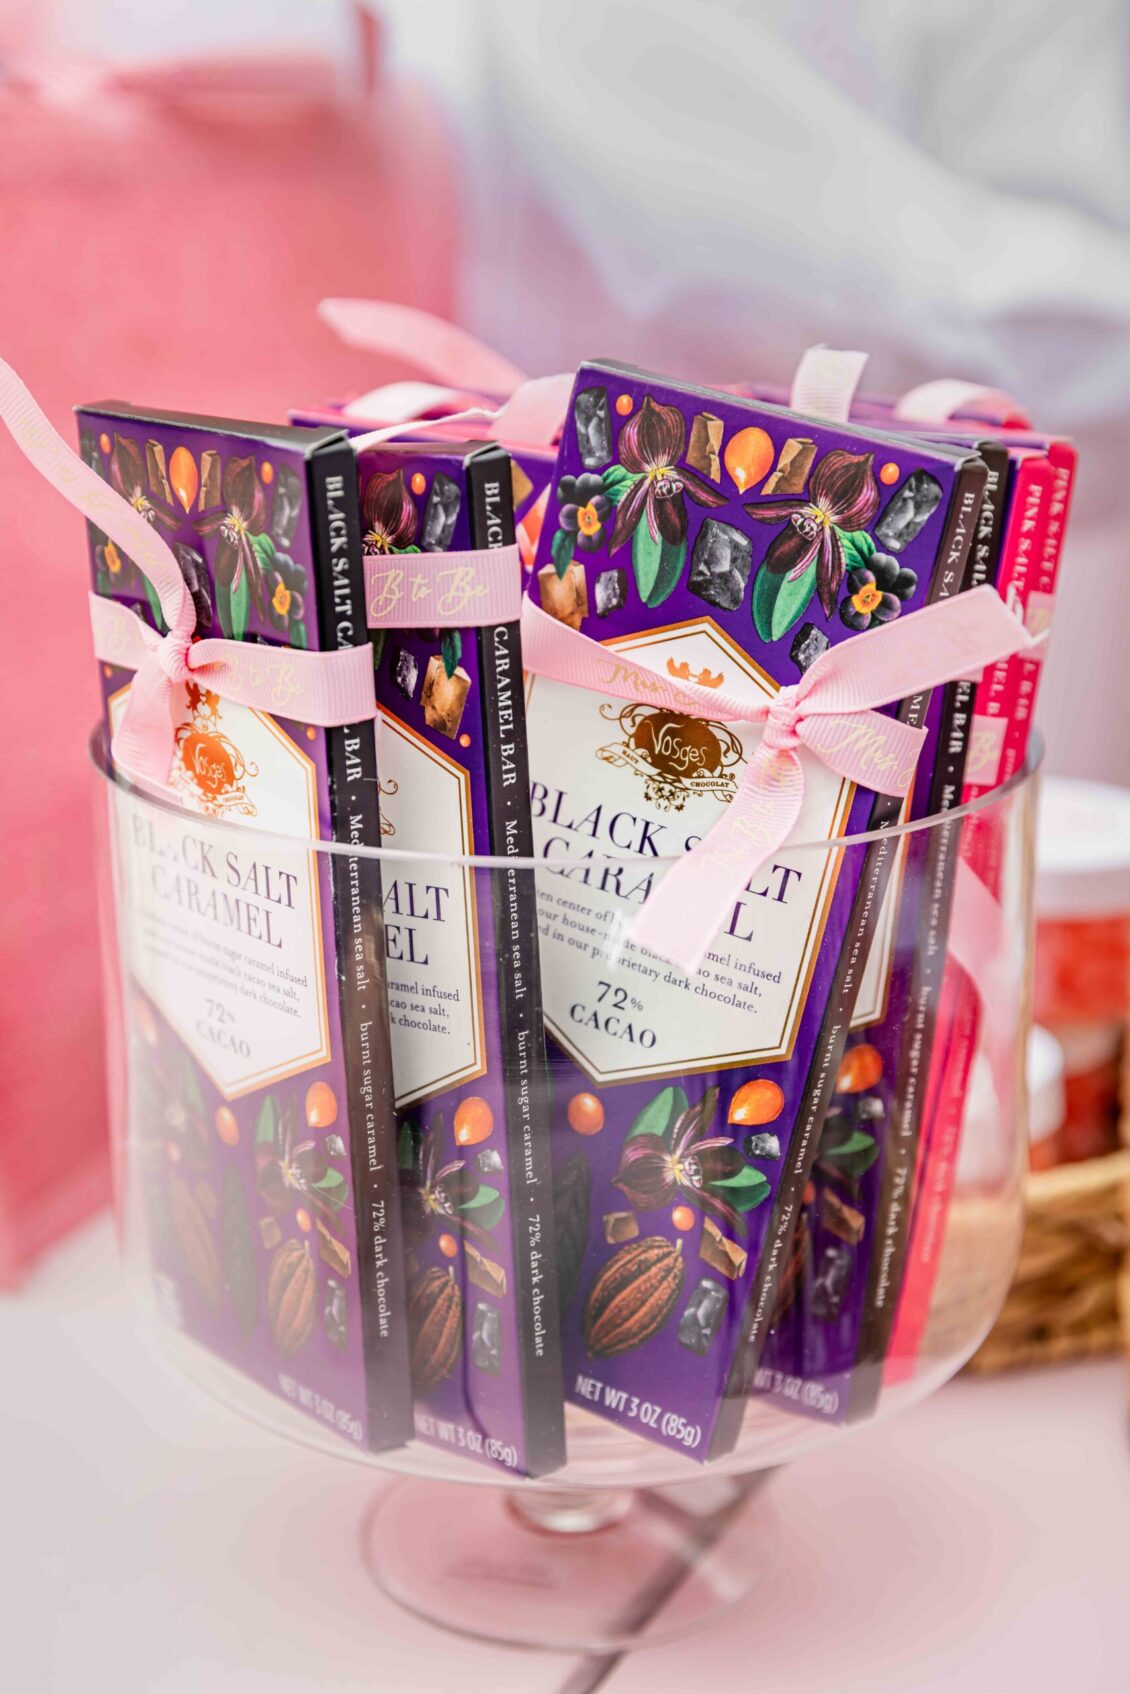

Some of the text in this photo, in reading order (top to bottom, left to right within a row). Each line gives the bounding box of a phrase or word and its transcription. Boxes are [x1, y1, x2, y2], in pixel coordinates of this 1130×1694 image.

[325, 475, 349, 553] BLACK
[977, 470, 999, 539] BLACK
[1020, 483, 1043, 533] PINK
[947, 492, 975, 565] BLACK
[331, 557, 352, 615] SALT
[939, 570, 954, 598] SA
[971, 544, 990, 588] SAL
[370, 566, 490, 617] B to Be
[493, 626, 515, 738] CARAMEL
[645, 720, 708, 771] Vosges
[948, 712, 967, 754] BAR
[190, 743, 227, 788] Vosges
[344, 736, 362, 782] BAR
[500, 742, 517, 787] BAR
[530, 780, 667, 858] BLACK
[226, 851, 298, 910] SALT
[349, 814, 364, 933] Medterranean
[505, 819, 519, 940] Mederranean
[151, 864, 283, 949] CARAMEL
[383, 879, 450, 922] ALT
[538, 908, 559, 921] our
[556, 897, 593, 917] center
[595, 911, 610, 922] of
[354, 937, 364, 961] sea
[511, 944, 521, 968] sea
[850, 941, 861, 964] sea
[244, 955, 275, 976] caramel
[277, 967, 308, 988] infused
[268, 983, 281, 994] sea
[283, 987, 301, 1002] salt,
[355, 966, 369, 991] salt
[388, 981, 460, 1002] ramel infused
[514, 972, 527, 1000] salt
[552, 930, 565, 942] in
[567, 937, 590, 952] our
[663, 971, 691, 990] dark
[694, 983, 758, 1014] chocolate.
[714, 975, 763, 998] sea salt,
[734, 959, 783, 984] infused
[842, 968, 854, 994] salt
[259, 992, 301, 1019] chocolate.
[390, 999, 450, 1018] cao sea salt,
[596, 980, 644, 1012] 72%
[360, 1020, 372, 1065] burnt
[398, 1014, 450, 1035] chocolate.
[569, 1003, 657, 1049] CACAO
[518, 1030, 530, 1075] burnt
[822, 1025, 842, 1068] burnt
[360, 1069, 374, 1110] sugar
[518, 1079, 531, 1121] sugar
[811, 1071, 827, 1113] sugar
[365, 1113, 383, 1172] caramel
[523, 1125, 538, 1185] caramel
[794, 1116, 814, 1174] caramel
[372, 1200, 386, 1232] 72%
[528, 1214, 542, 1247] 72%
[777, 1204, 793, 1236] 72%
[373, 1234, 389, 1269] dark
[530, 1251, 544, 1285] dark
[768, 1239, 783, 1272] dark
[376, 1272, 392, 1338] chocolate
[532, 1288, 546, 1357] chocolate
[748, 1275, 772, 1343] chocolate
[575, 1375, 702, 1448] NET WT 3 OZ (85g)
[437, 1422, 455, 1443] WT
[458, 1428, 466, 1446] 3
[467, 1431, 483, 1454] OZ
[485, 1436, 518, 1468] (85g)
